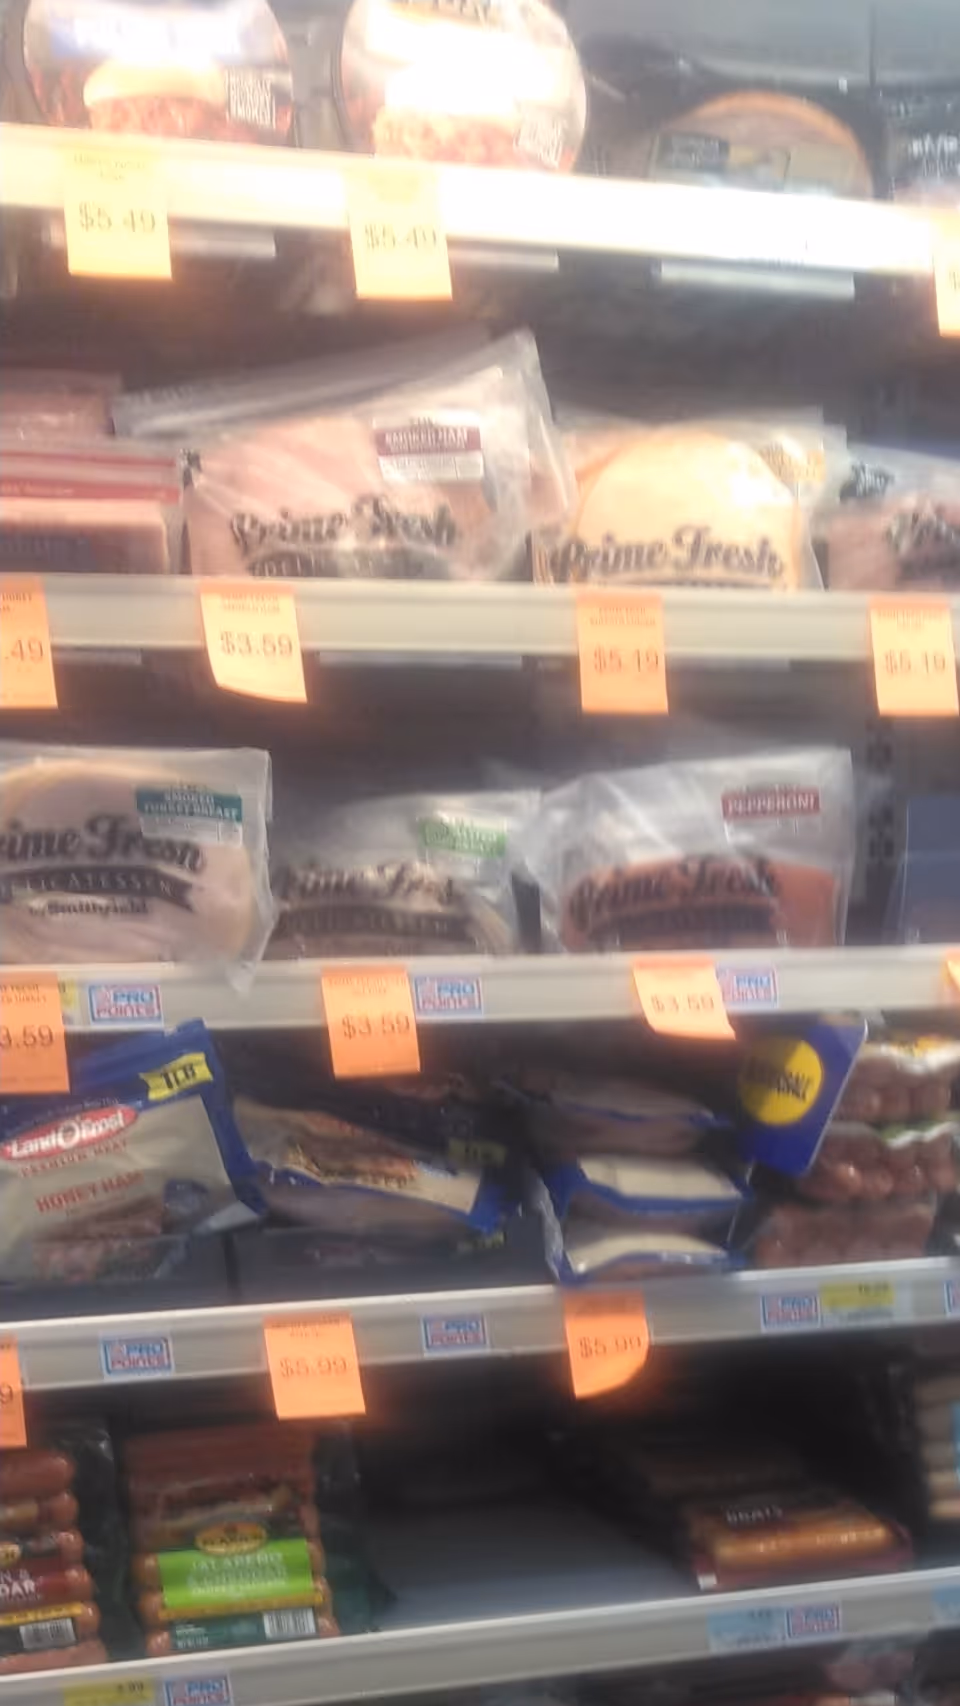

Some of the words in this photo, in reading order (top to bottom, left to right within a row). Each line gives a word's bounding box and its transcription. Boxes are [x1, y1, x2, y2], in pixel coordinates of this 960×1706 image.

[219, 631, 294, 657] $3.59
[437, 982, 475, 995] PRO
[112, 990, 155, 1003] PRO
[126, 1342, 163, 1355] PRO
[185, 1680, 224, 1694] PRO
